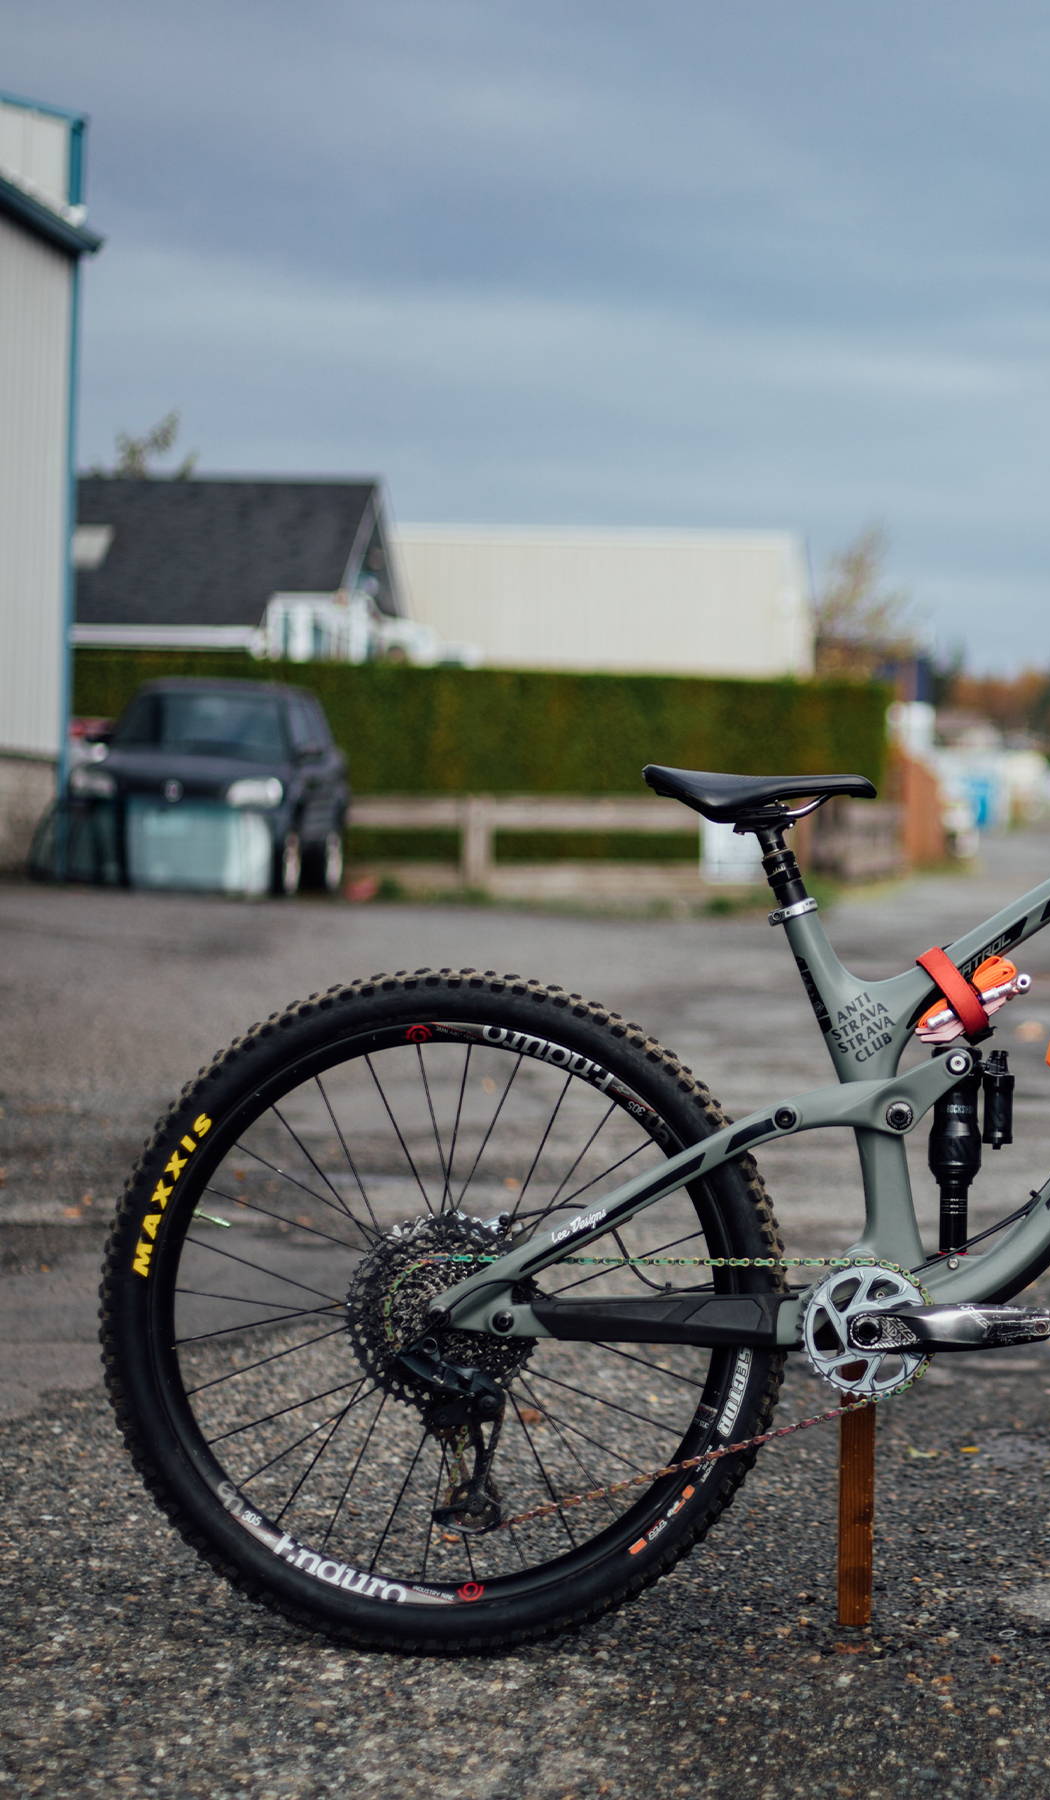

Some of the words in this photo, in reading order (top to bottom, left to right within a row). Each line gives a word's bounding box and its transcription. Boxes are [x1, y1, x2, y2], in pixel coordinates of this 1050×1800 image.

[960, 935, 1012, 975] ATROL
[831, 1002, 889, 1040] STRAVA
[837, 992, 871, 1024] ANTI
[838, 1016, 896, 1053] STRAVA
[855, 1032, 892, 1062] CLUB
[483, 1025, 614, 1093] Enduro
[626, 1101, 646, 1116] 305
[132, 1113, 212, 1277] MAXXIS
[569, 1208, 607, 1233] Designs
[717, 1347, 754, 1437] SECTOR
[241, 1510, 262, 1527] 305
[274, 1531, 407, 1603] Enduro
